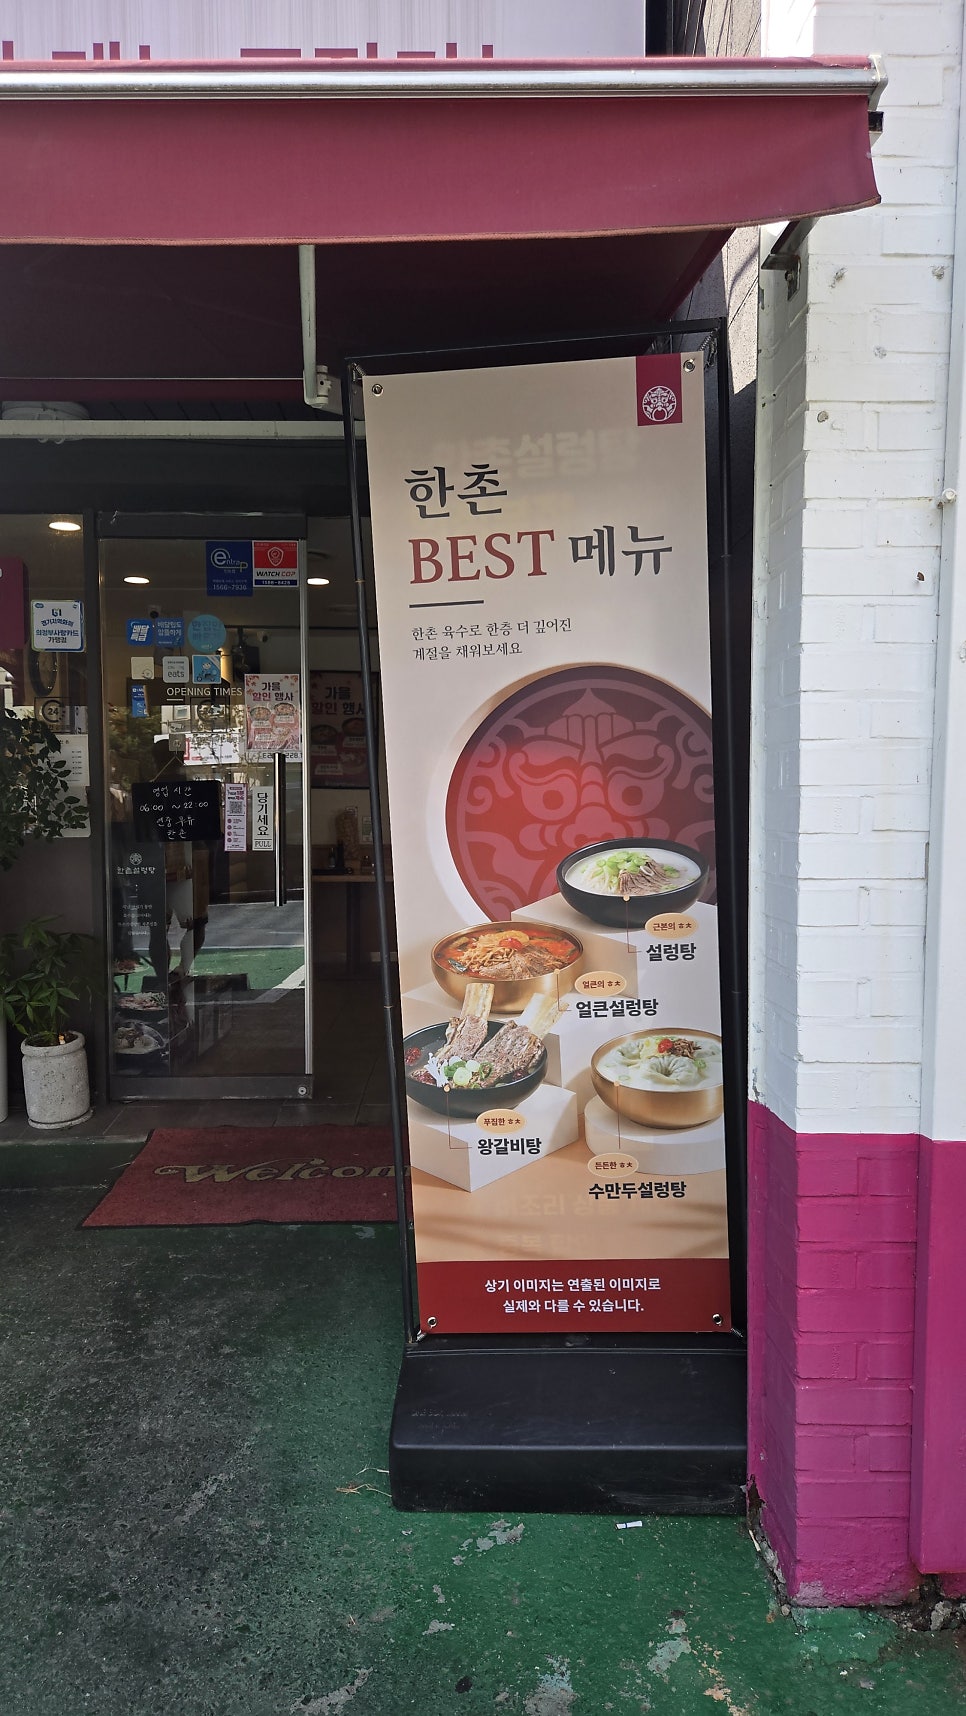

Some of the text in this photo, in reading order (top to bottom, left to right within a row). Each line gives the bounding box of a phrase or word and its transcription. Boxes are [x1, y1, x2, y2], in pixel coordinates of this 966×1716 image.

[404, 463, 508, 519] 한촌
[408, 525, 673, 584] BEST 메뉴
[411, 617, 572, 641] 한촌 육수로 한층 더 깊어진
[413, 642, 522, 661] 계절을 채워보세요
[167, 670, 185, 678] eats
[166, 687, 243, 696] OPENING TIMES
[261, 682, 281, 691] 가을
[252, 692, 294, 702] 할인 행사
[153, 786, 169, 797] 영업
[257, 792, 269, 836] 당기세요
[254, 840, 272, 848] PULL
[653, 922, 676, 931] 근본의
[646, 942, 697, 962] 설렁탕
[576, 999, 659, 1019] 얼큰설렁탕
[484, 1117, 505, 1126] 푸짐한
[478, 1137, 542, 1156] 왕갈비탕
[154, 1157, 411, 1183] Welcom
[595, 1161, 617, 1170] 든든한
[589, 1181, 687, 1200] 수만두설렁탕
[484, 1277, 662, 1293] 상기 이미지는 연출된 이미지로
[502, 1298, 645, 1313] 실제와 다를 수 있습니다.
